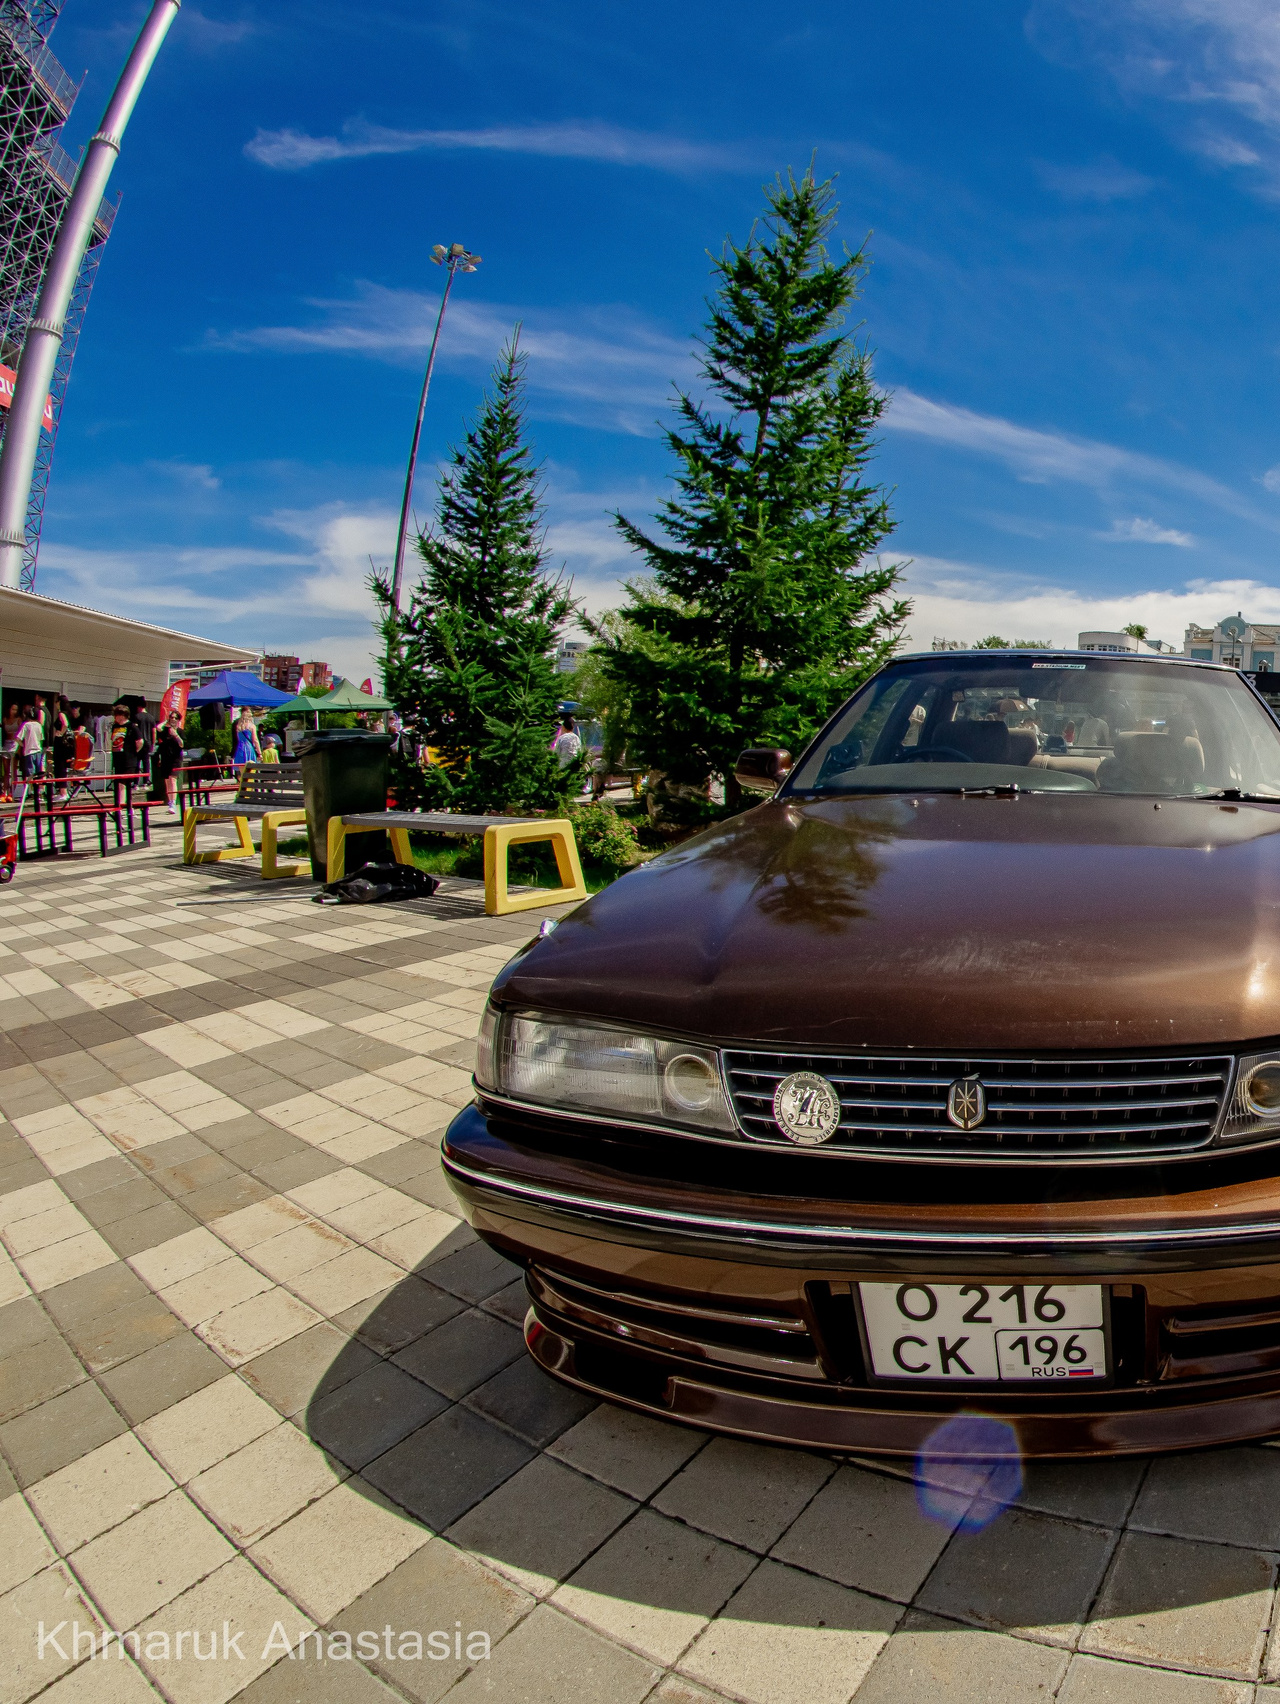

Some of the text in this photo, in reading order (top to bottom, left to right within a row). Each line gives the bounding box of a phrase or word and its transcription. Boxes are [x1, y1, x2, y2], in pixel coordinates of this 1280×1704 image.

[791, 1072, 822, 1083] JAPAN
[775, 1088, 800, 1142] FEDERATION
[958, 1284, 1066, 1324] 216
[1008, 1334, 1088, 1366] 196
[1031, 1366, 1067, 1377] RUS
